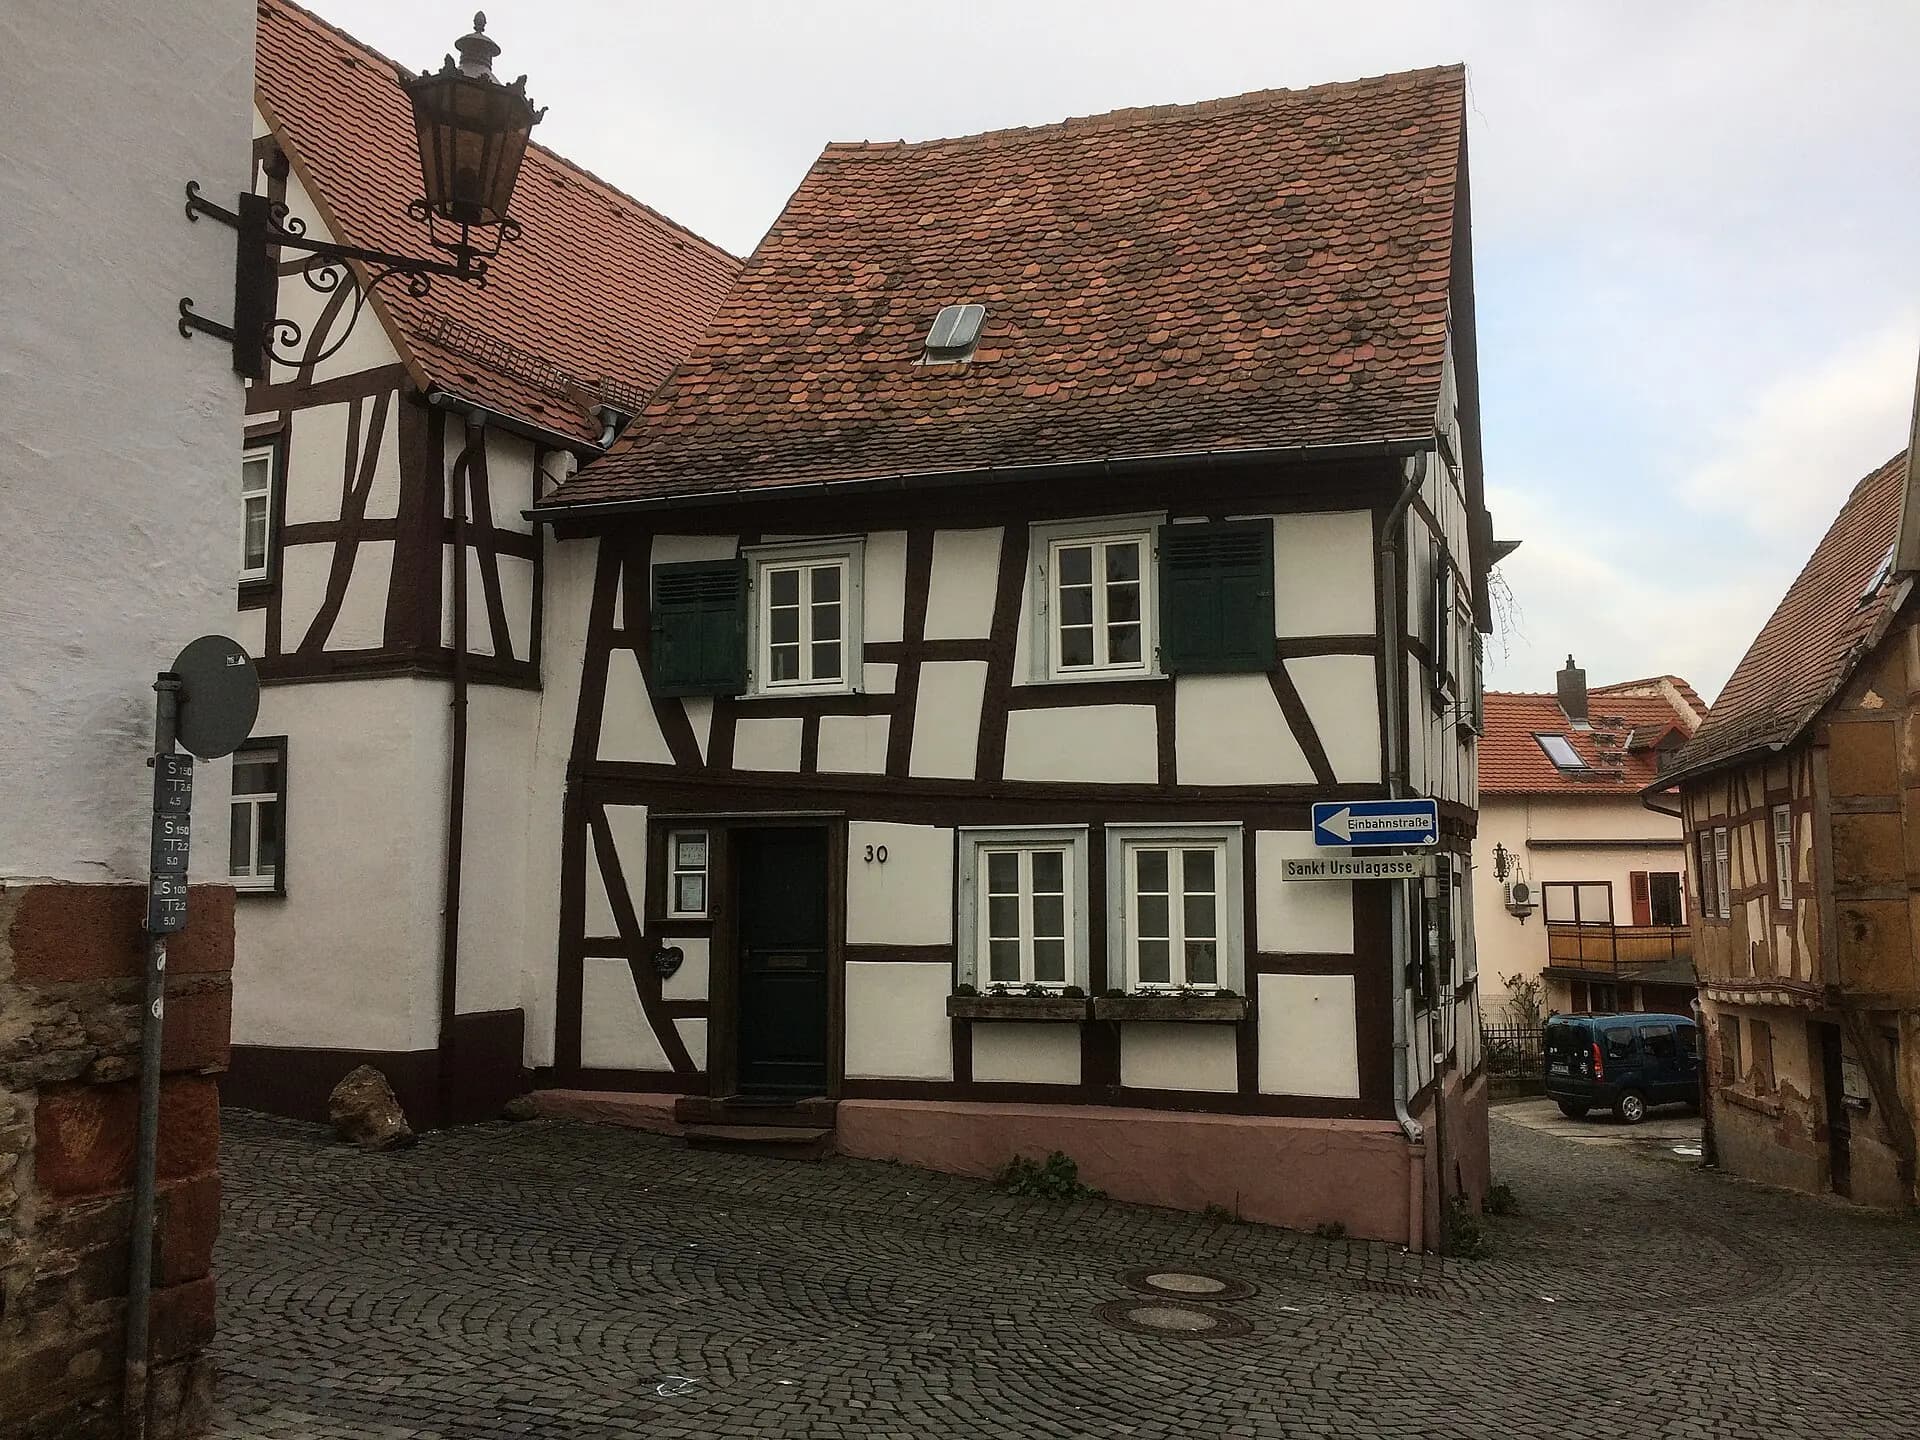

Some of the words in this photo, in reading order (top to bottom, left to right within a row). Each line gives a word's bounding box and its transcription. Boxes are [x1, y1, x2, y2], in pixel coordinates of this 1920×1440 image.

[168, 761, 177, 774] S
[164, 821, 174, 834] S
[176, 826, 189, 835] 150
[1347, 817, 1430, 830] Einbahnstraße
[863, 844, 888, 863] 30
[1288, 861, 1326, 875] Sankt
[1330, 860, 1413, 877] Ursulagasse
[162, 881, 171, 894] S
[173, 885, 187, 894] 100
[163, 916, 176, 926] 5.0
